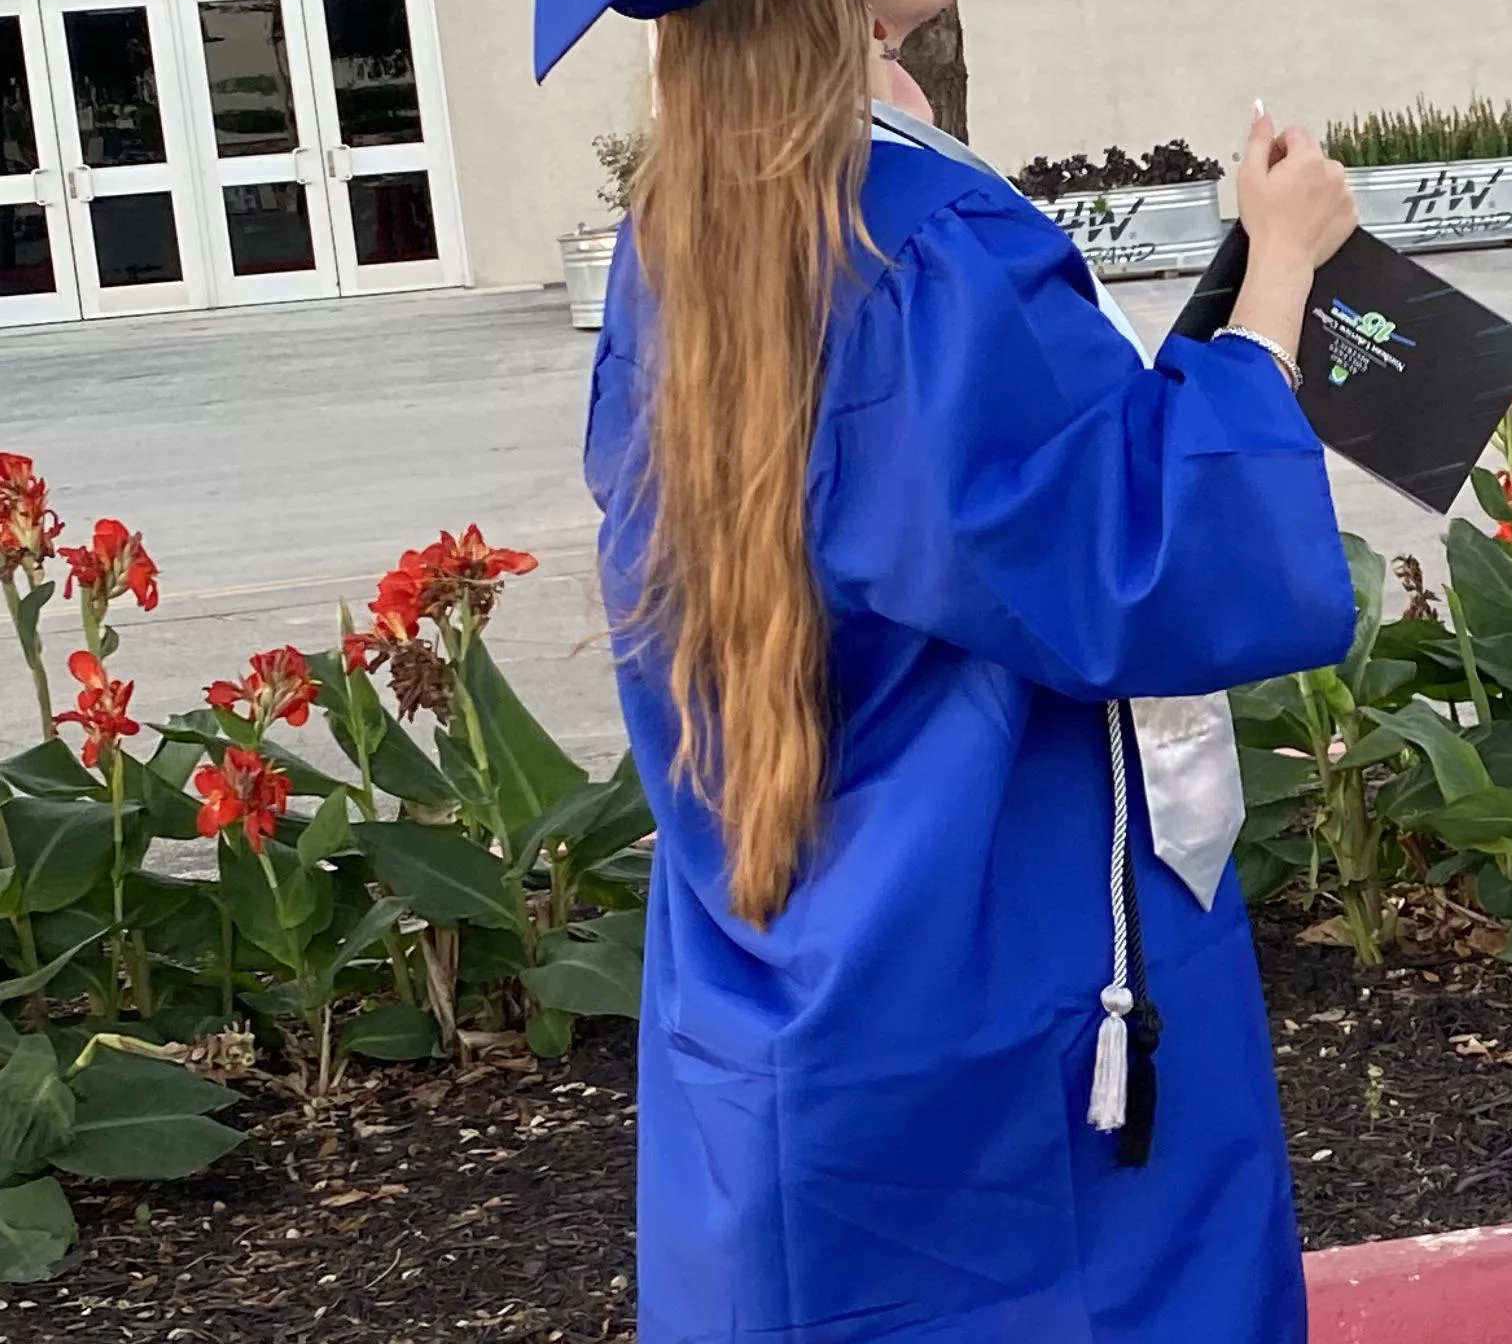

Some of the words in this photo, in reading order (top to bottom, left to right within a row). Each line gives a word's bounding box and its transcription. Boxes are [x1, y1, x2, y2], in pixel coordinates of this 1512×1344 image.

[1402, 168, 1504, 223] HW
[1412, 211, 1512, 243] BRAND
[1084, 242, 1156, 265] RAND
